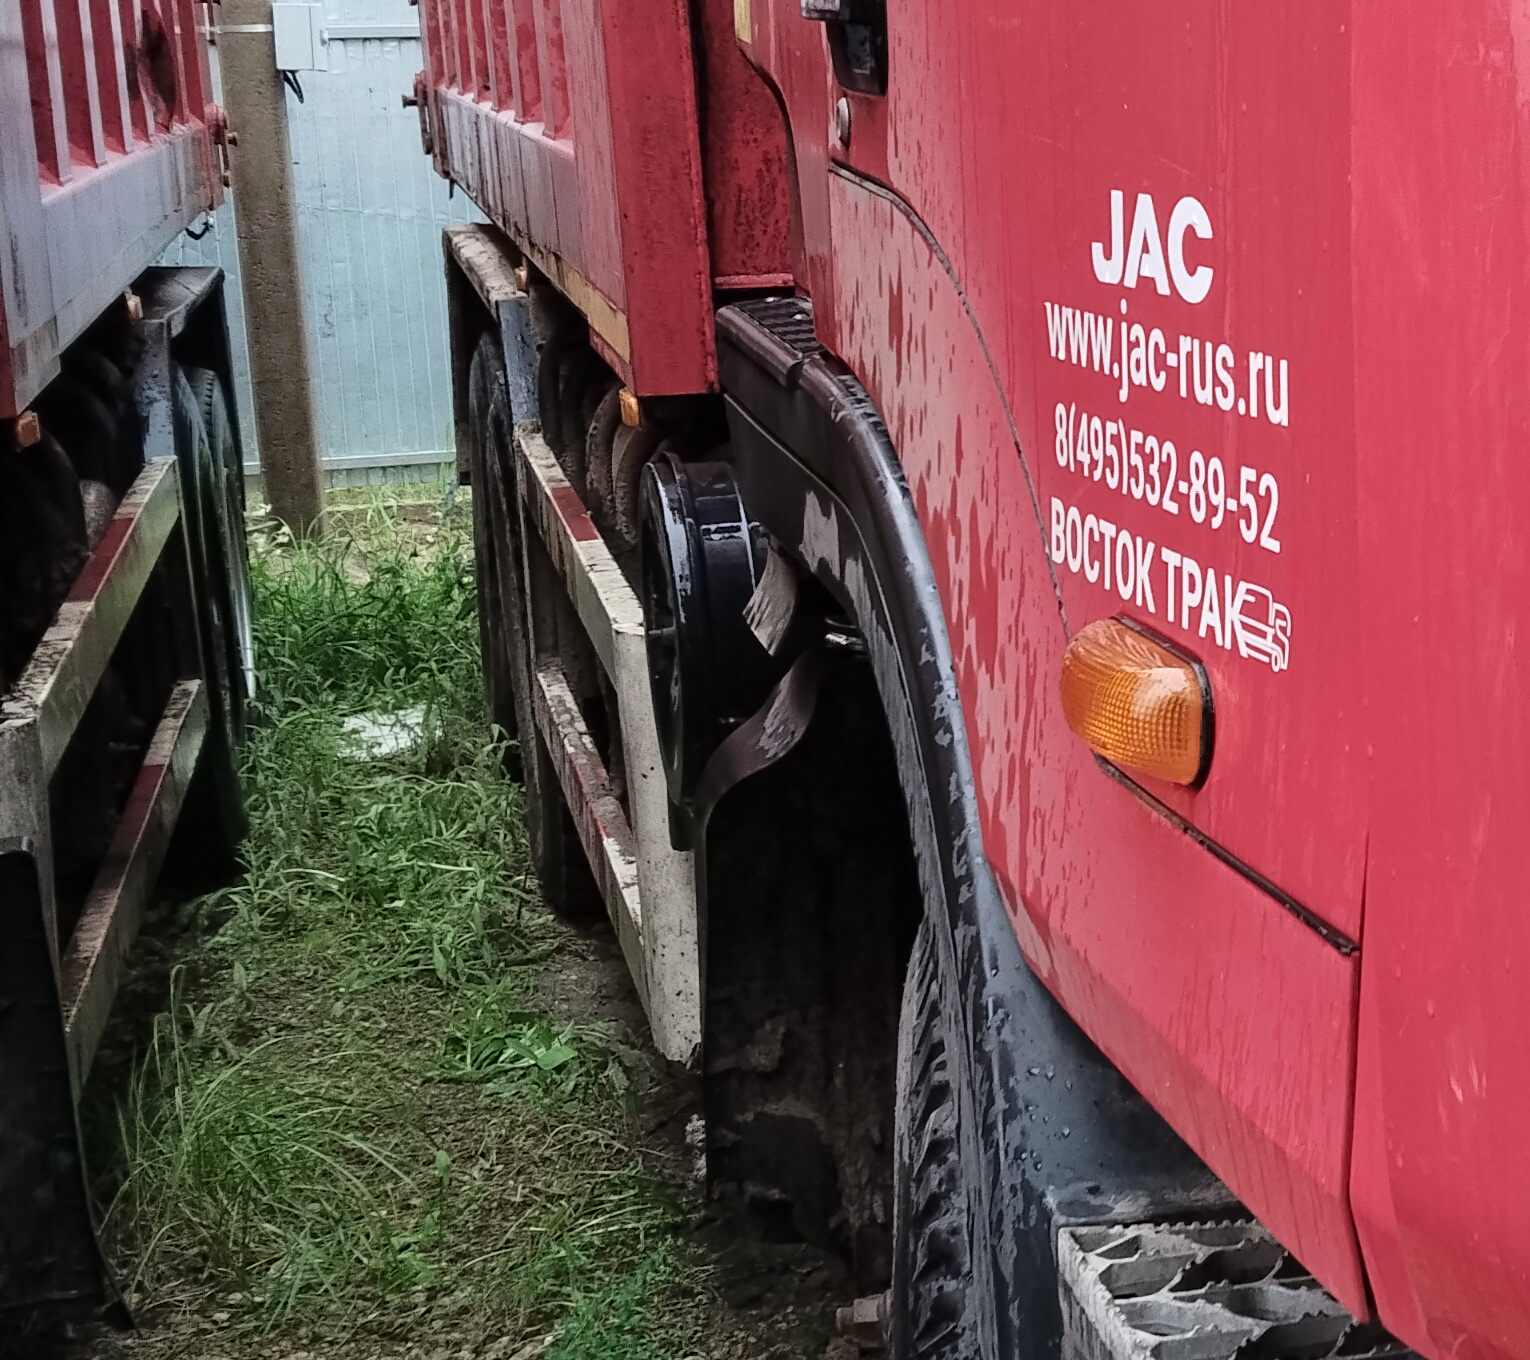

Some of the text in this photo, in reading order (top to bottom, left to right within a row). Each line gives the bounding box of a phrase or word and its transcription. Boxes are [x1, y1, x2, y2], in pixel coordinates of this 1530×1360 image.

[1091, 189, 1214, 304] JAC
[1044, 298, 1290, 427] www.jac-rus.ru
[1054, 402, 1281, 554] 8(495)532-89-52
[1050, 496, 1249, 658] ВОСТОК ТРАК
